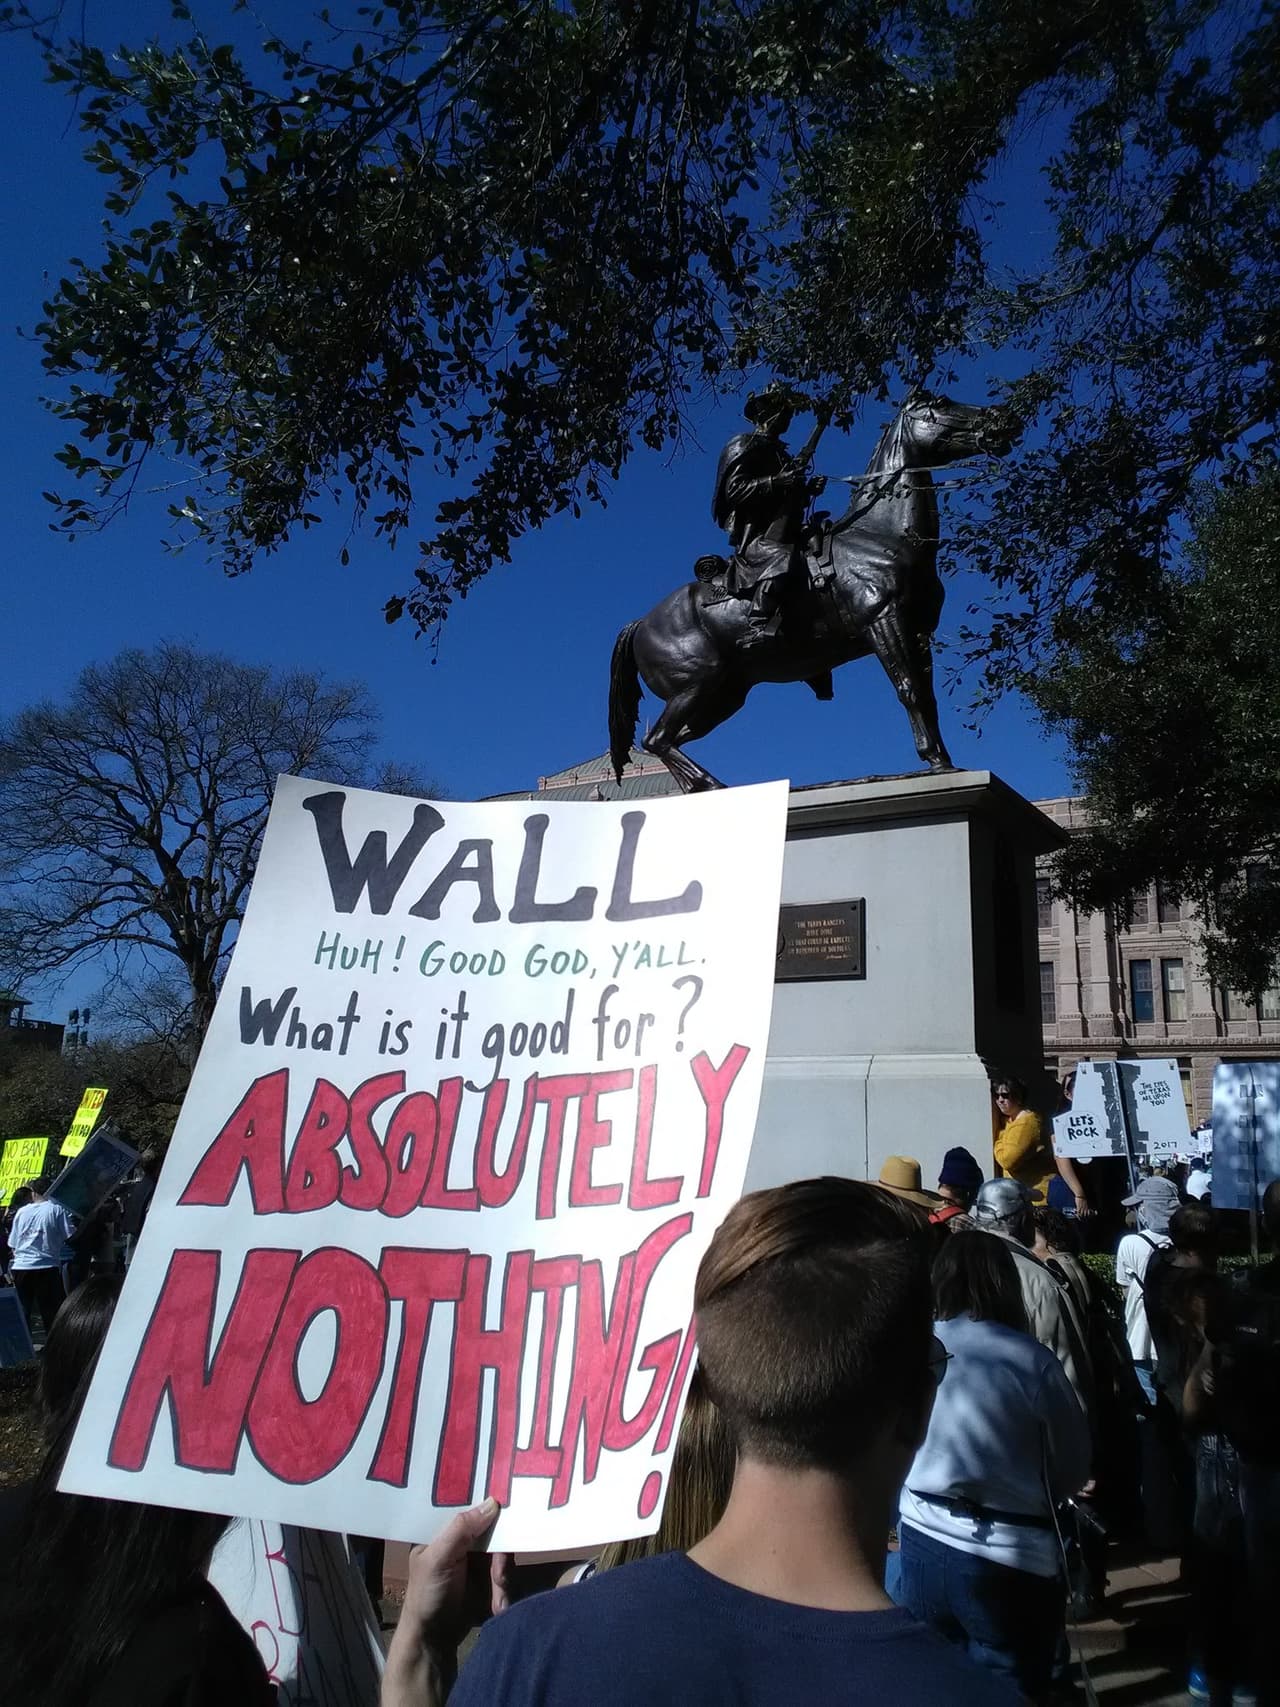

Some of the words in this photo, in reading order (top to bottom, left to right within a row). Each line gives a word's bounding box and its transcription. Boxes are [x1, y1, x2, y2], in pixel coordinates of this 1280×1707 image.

[302, 791, 704, 924] WALL
[314, 930, 406, 975] HUH!
[419, 940, 505, 977] GOOD
[524, 943, 597, 979] GOD,
[611, 940, 706, 978] Y'ALL.
[239, 986, 361, 1055] What
[378, 1009, 413, 1056] is
[435, 990, 469, 1060] it
[465, 987, 576, 1092] good
[1148, 1086, 1171, 1095] TEXAS
[1149, 1099, 1166, 1107] YOU
[1069, 1113, 1095, 1127] LET'S
[176, 1044, 750, 1220] ABSOLUTELY
[1067, 1127, 1100, 1140] ROCK
[5, 1141, 19, 1158] NO
[20, 1140, 44, 1157] BAN
[1153, 1141, 1178, 1150] 2017
[15, 1158, 41, 1175] WALL
